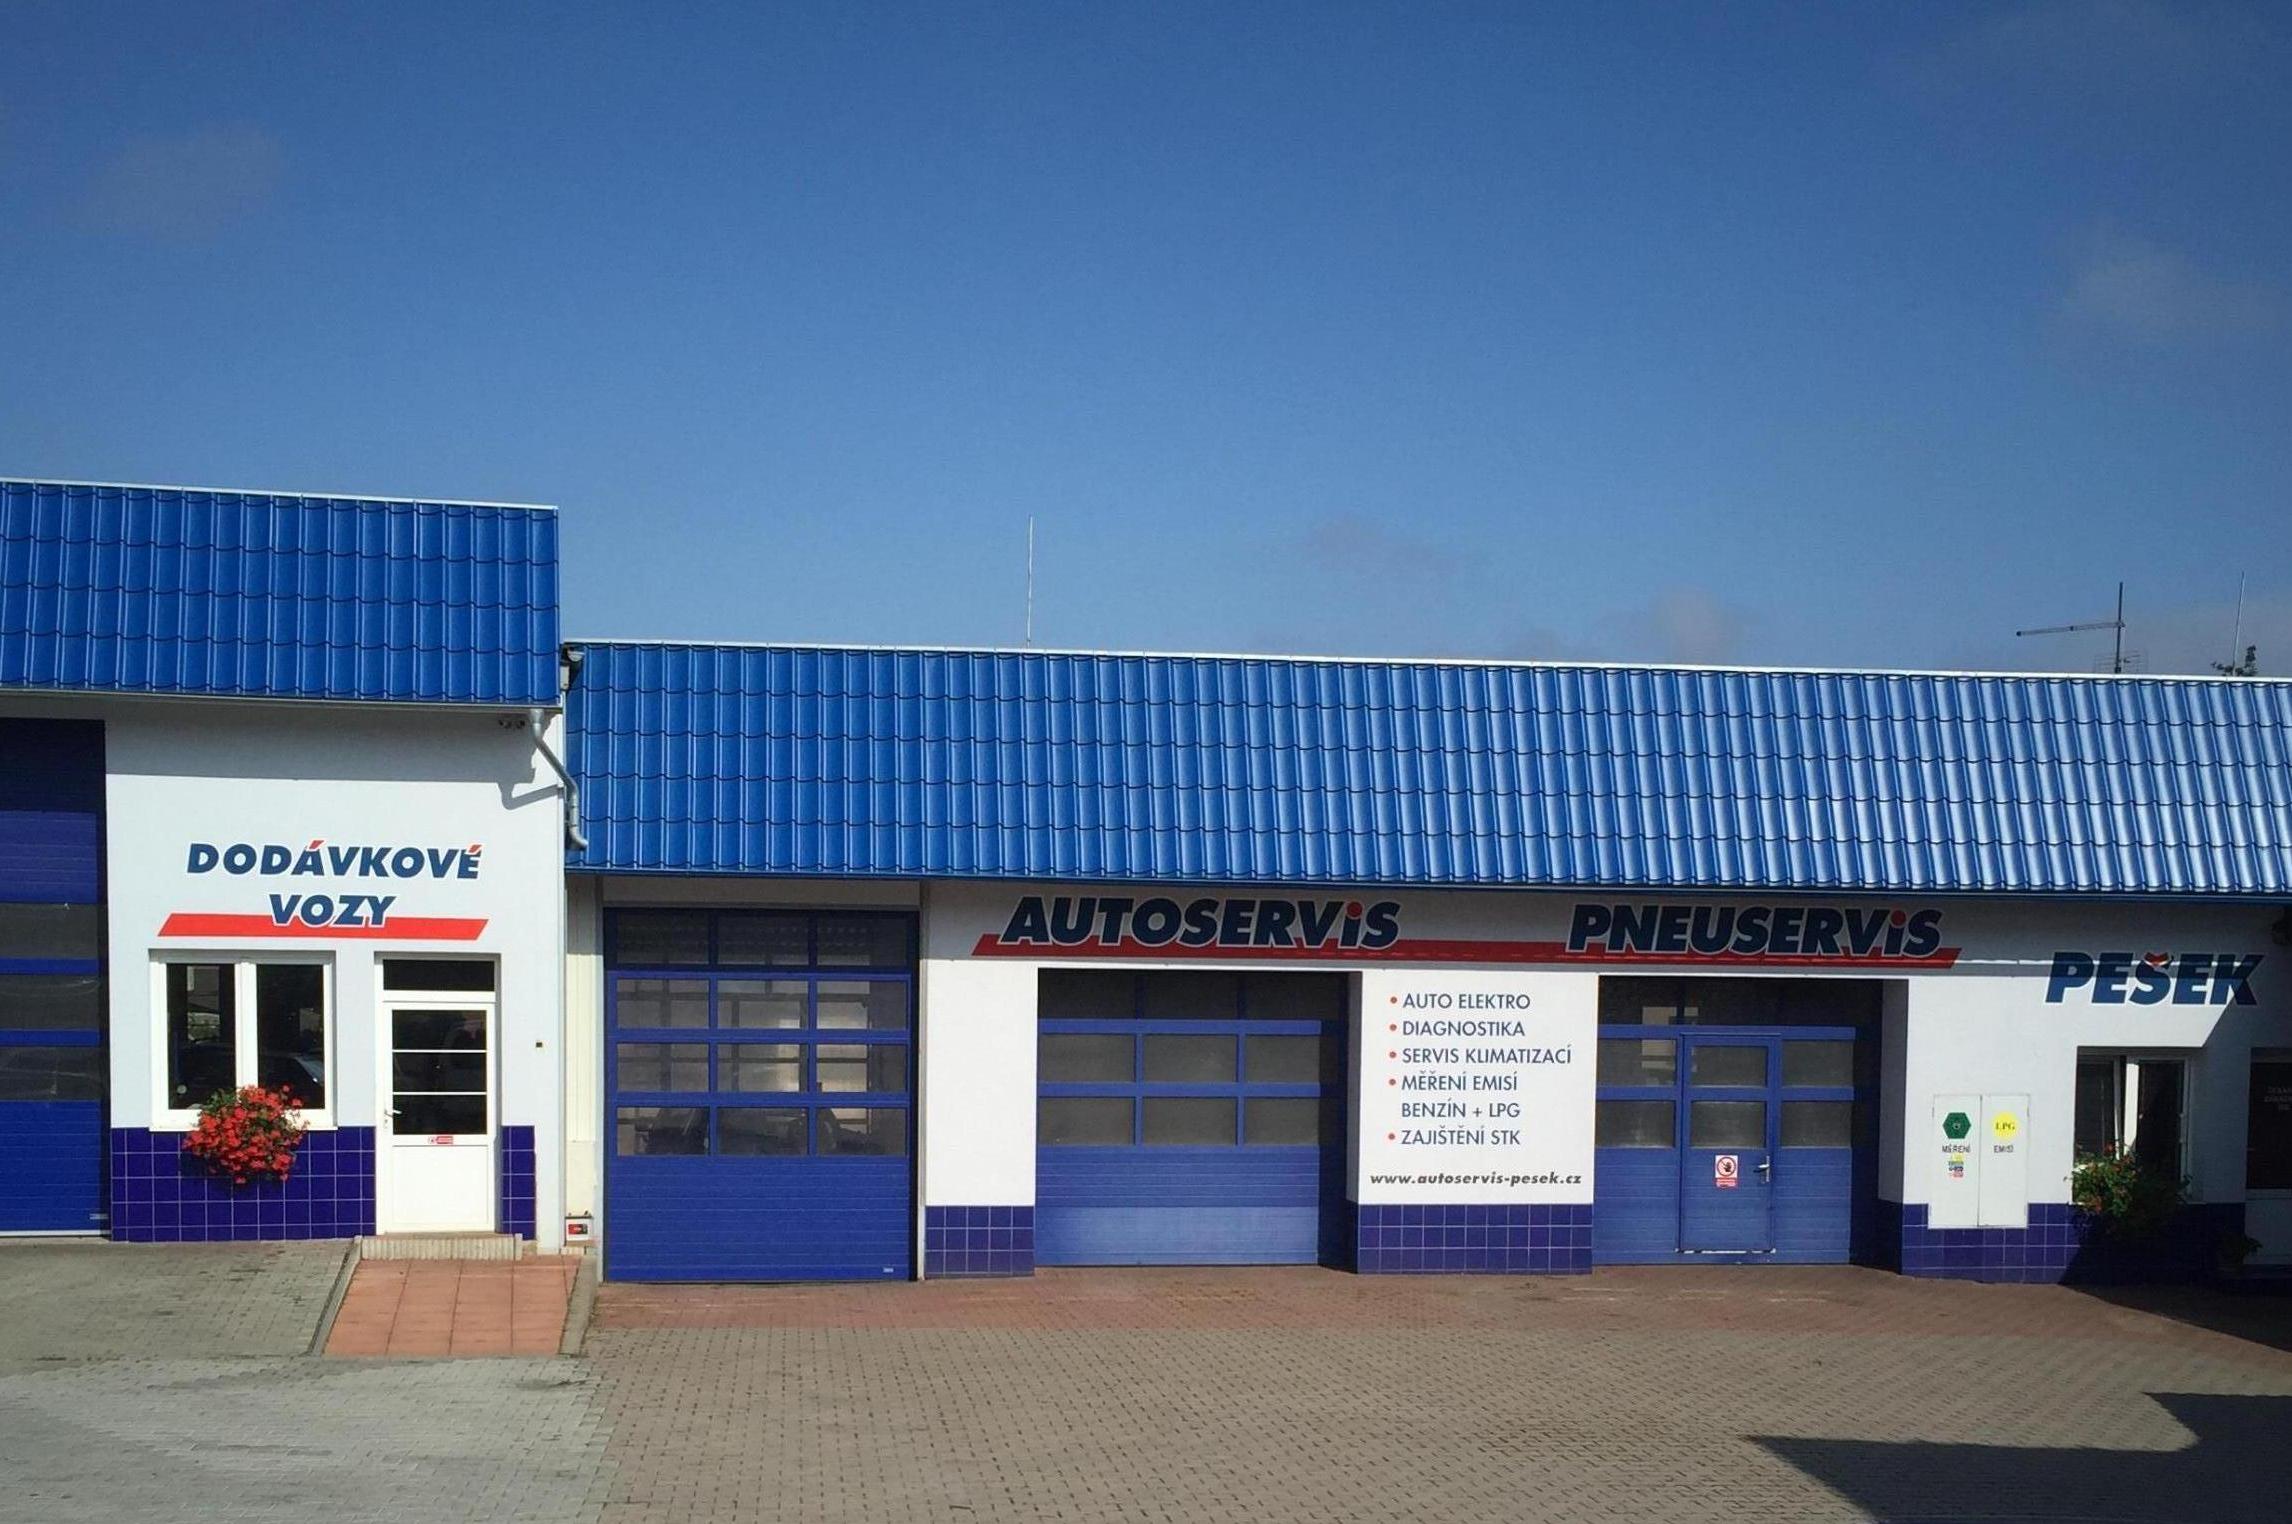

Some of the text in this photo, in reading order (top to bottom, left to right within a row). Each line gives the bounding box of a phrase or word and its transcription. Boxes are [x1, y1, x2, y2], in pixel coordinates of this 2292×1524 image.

[187, 839, 482, 879] DODÁVKOVÉ
[269, 894, 397, 926] VOZY
[2045, 951, 2265, 1006] PEŠEK
[1402, 993, 1531, 1010] AUTO ELEKTRO
[1402, 1020, 1526, 1037] DIAGNOSTIKA
[1402, 1043, 1573, 1064] SERVIS KLIMATIZACÍ
[1401, 1069, 1518, 1091] MĚŘENÍ EMISÍ
[1401, 1097, 1466, 1118] BENZÍN
[1489, 1102, 1521, 1118] LPG
[1401, 1124, 1521, 1145] ZAJIŠTĚNÍ STK
[1370, 1171, 1583, 1188] www.autoservis-pesek.cz
